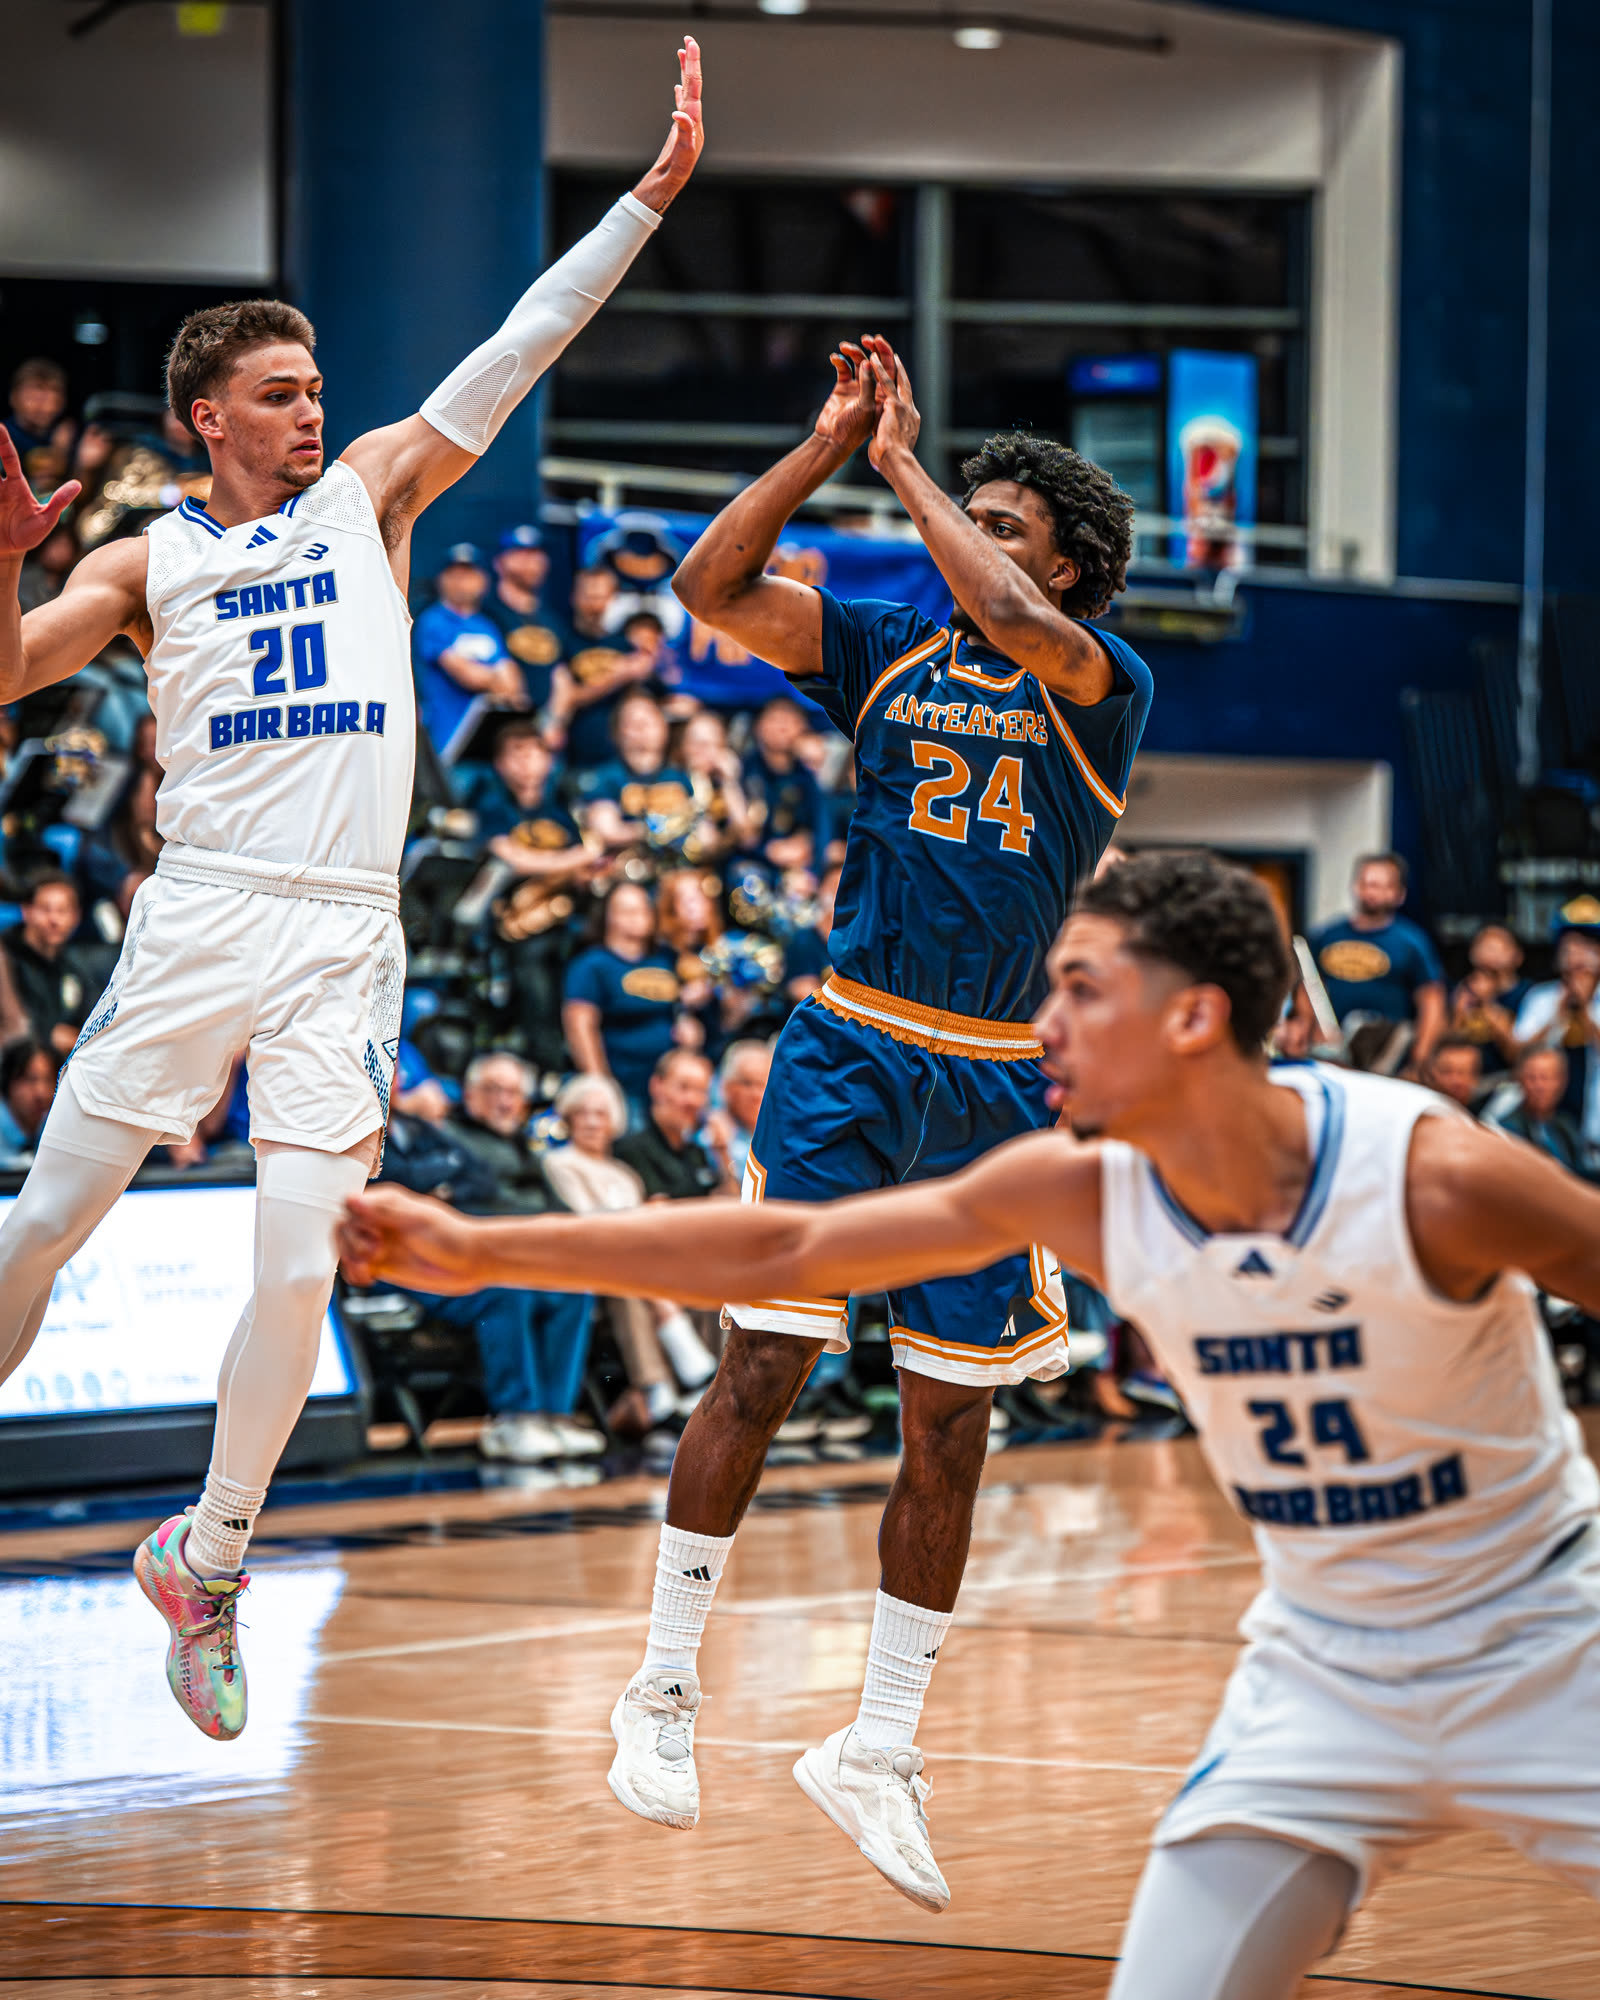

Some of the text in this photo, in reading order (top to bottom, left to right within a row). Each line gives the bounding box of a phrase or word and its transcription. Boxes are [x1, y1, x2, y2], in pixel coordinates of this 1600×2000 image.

[214, 569, 338, 623] SANTA
[248, 621, 328, 699] 20
[209, 700, 387, 753] BARBARA
[884, 693, 1048, 746] ANTEATERS
[908, 740, 1036, 857] 24
[1193, 1325, 1363, 1375] SANTA
